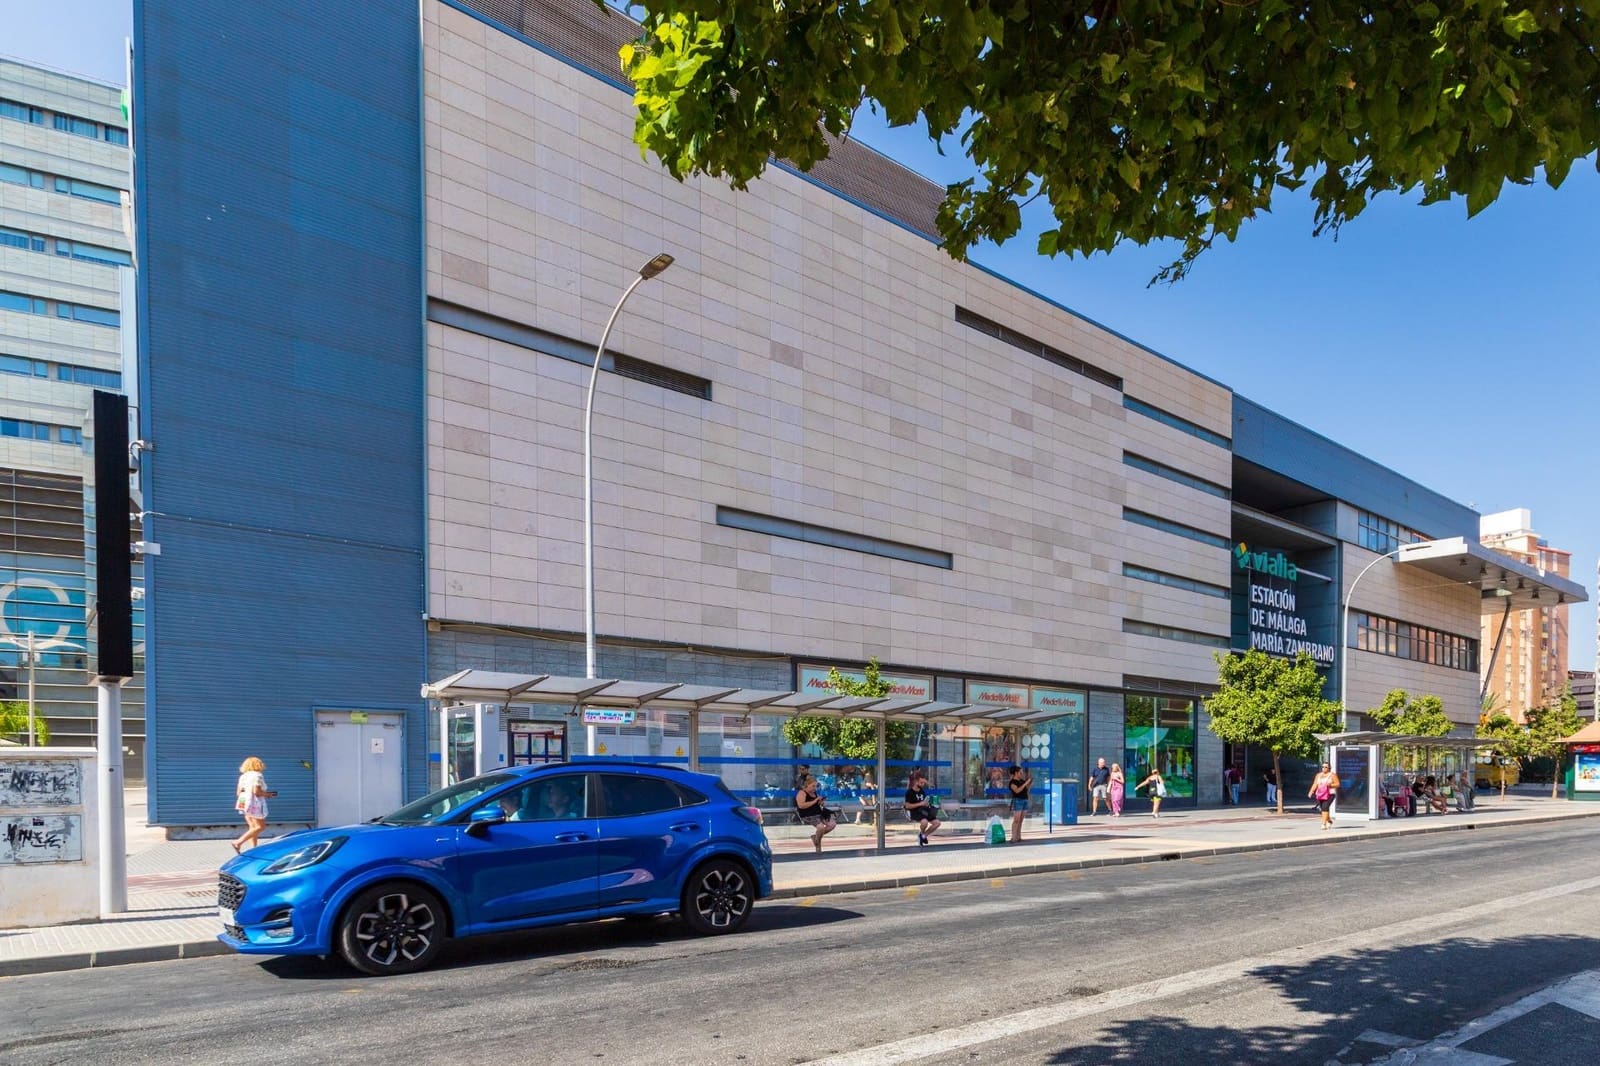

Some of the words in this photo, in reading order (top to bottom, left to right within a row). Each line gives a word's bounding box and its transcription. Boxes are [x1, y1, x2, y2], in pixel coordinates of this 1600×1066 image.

[1252, 552, 1297, 582] vialia
[1251, 584, 1296, 612] ESTACIÓN
[1251, 607, 1266, 628] DE
[1268, 609, 1307, 636] MÁLAGA
[1251, 631, 1284, 655] MARÍA
